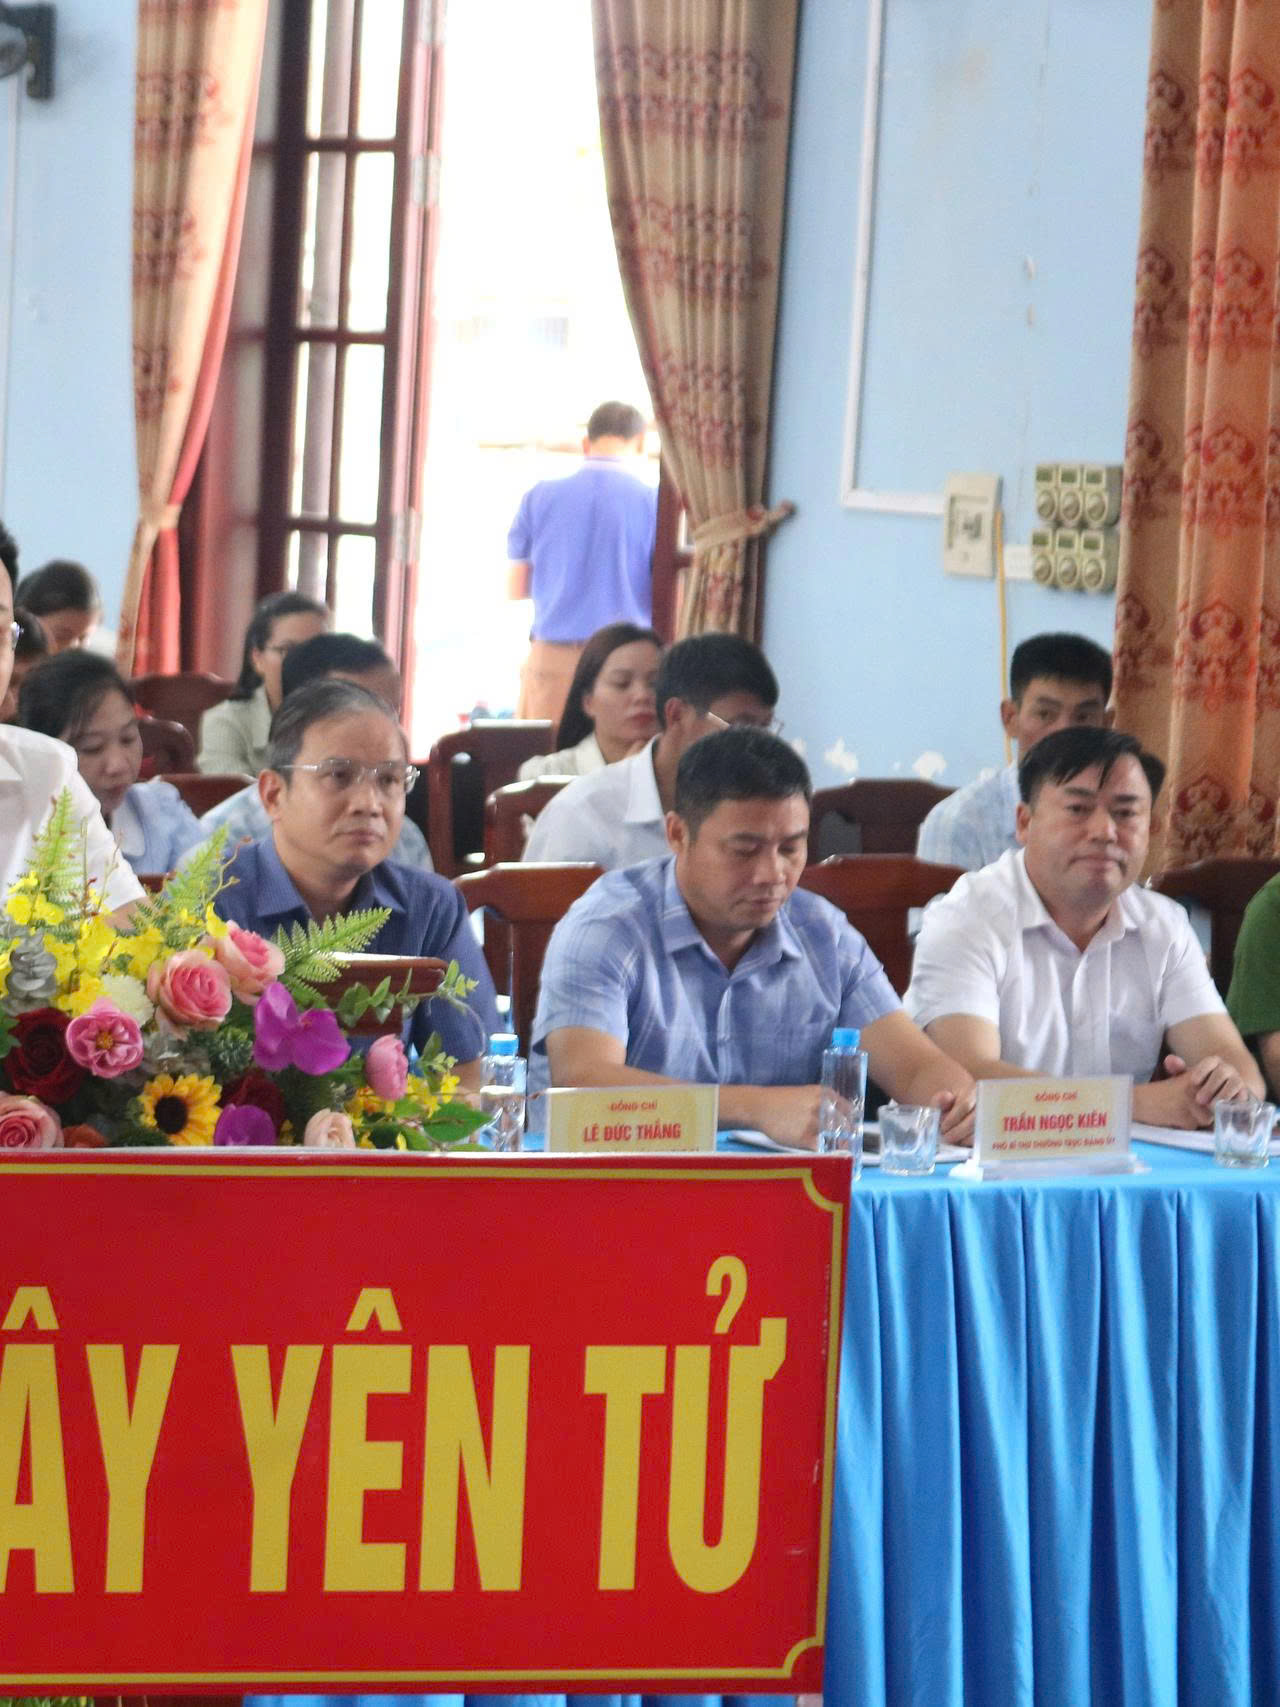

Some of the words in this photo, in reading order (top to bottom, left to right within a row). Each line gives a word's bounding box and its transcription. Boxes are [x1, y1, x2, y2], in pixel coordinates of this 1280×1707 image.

[583, 1122, 599, 1142] LÊ
[603, 1122, 632, 1142] ĐỨC
[636, 1118, 681, 1140] THẮNG
[1039, 1113, 1074, 1133] NGỌC
[231, 1288, 530, 1593] YÊN
[584, 1257, 787, 1593] TỬ
